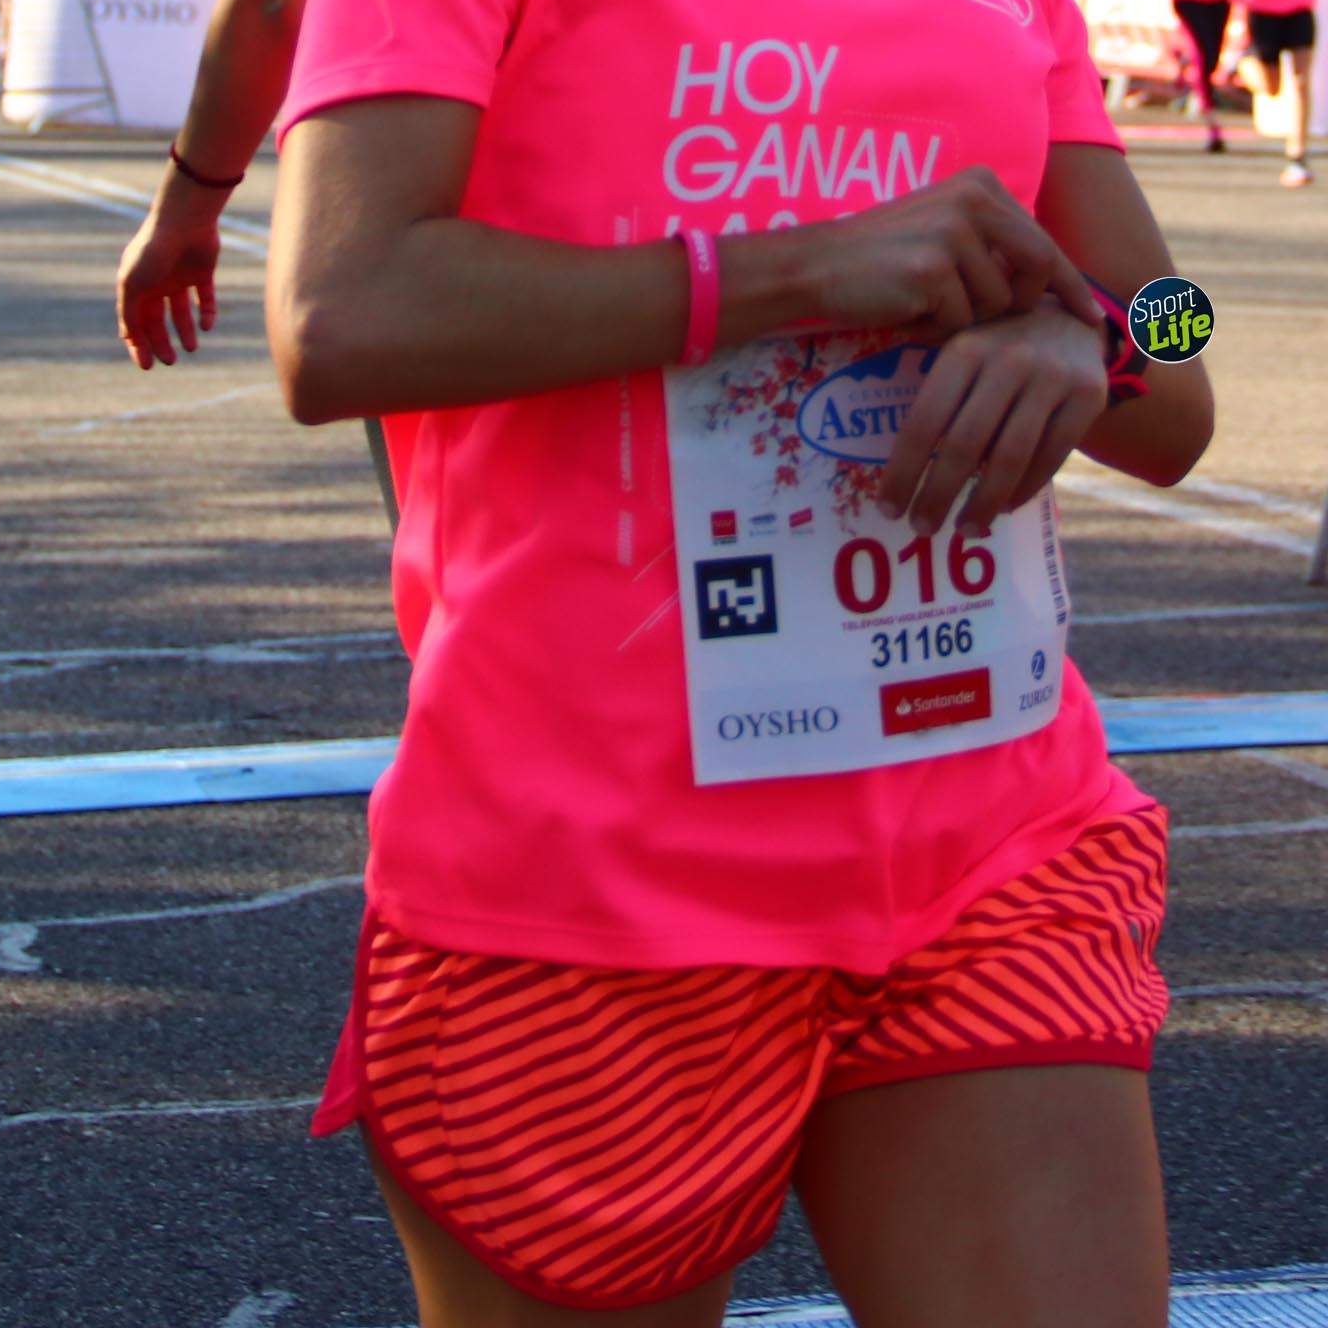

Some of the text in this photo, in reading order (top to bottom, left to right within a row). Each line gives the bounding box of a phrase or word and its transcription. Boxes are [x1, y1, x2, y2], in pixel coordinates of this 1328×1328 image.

[669, 39, 839, 118] HOY
[663, 123, 940, 203] GANAN
[833, 525, 996, 614] 016
[871, 618, 974, 668] 31166
[717, 705, 840, 741] OYSHO
[913, 689, 977, 714] Santander
[1019, 684, 1056, 712] ZURICH
